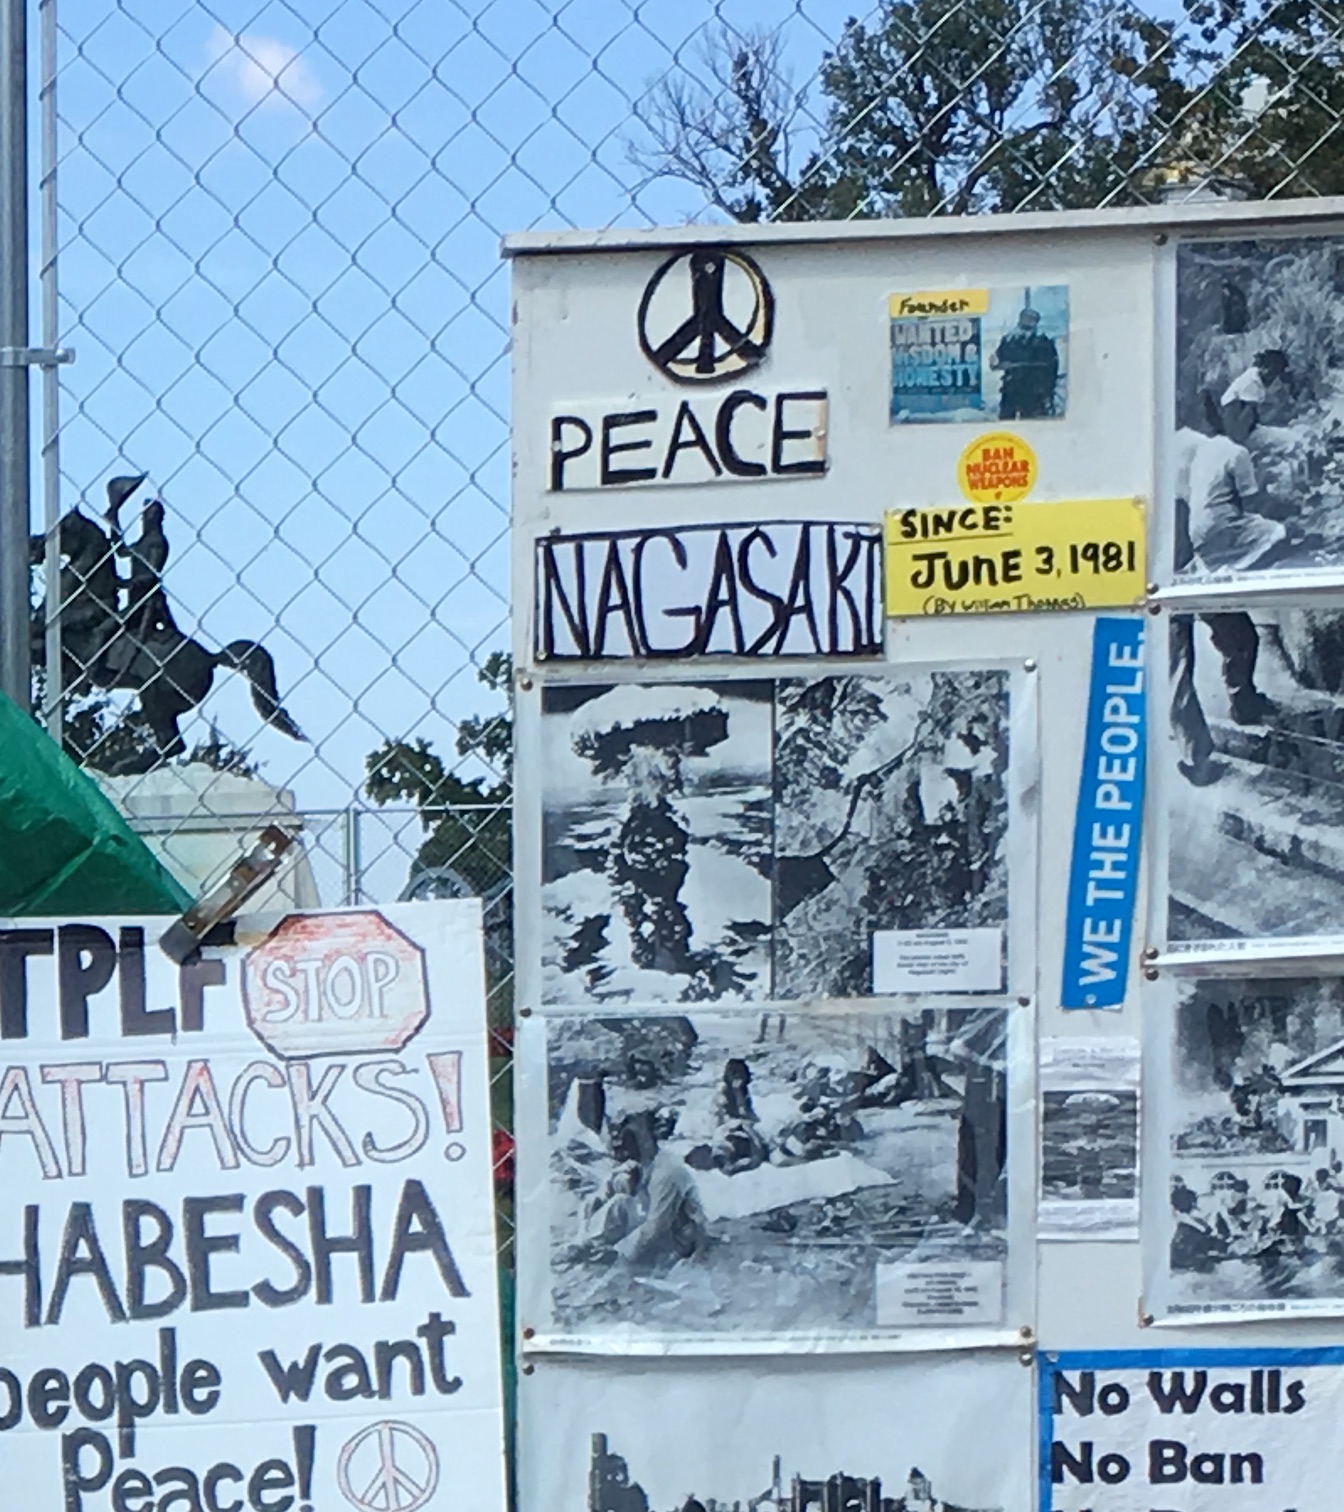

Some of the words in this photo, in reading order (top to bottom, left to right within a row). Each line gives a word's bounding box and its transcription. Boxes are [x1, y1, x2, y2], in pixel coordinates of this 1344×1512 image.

[551, 390, 827, 491] PEACE
[965, 460, 1030, 476] NUCLEAR
[981, 446, 1015, 461] BAN
[967, 473, 1029, 491] WEAPONS
[901, 505, 1013, 539] SINCE:
[1070, 541, 1136, 576] 1981
[541, 525, 884, 656] NAGASAKI
[1095, 627, 1147, 812] PEOPLE.
[1085, 821, 1132, 908] THE
[1078, 916, 1123, 987] WE
[260, 952, 401, 1023] STOP
[258, 1311, 464, 1403] want
[1052, 1369, 1131, 1418] No
[1146, 1369, 1307, 1416] Walls
[1051, 1440, 1132, 1484] No
[1148, 1438, 1265, 1485] Ban
